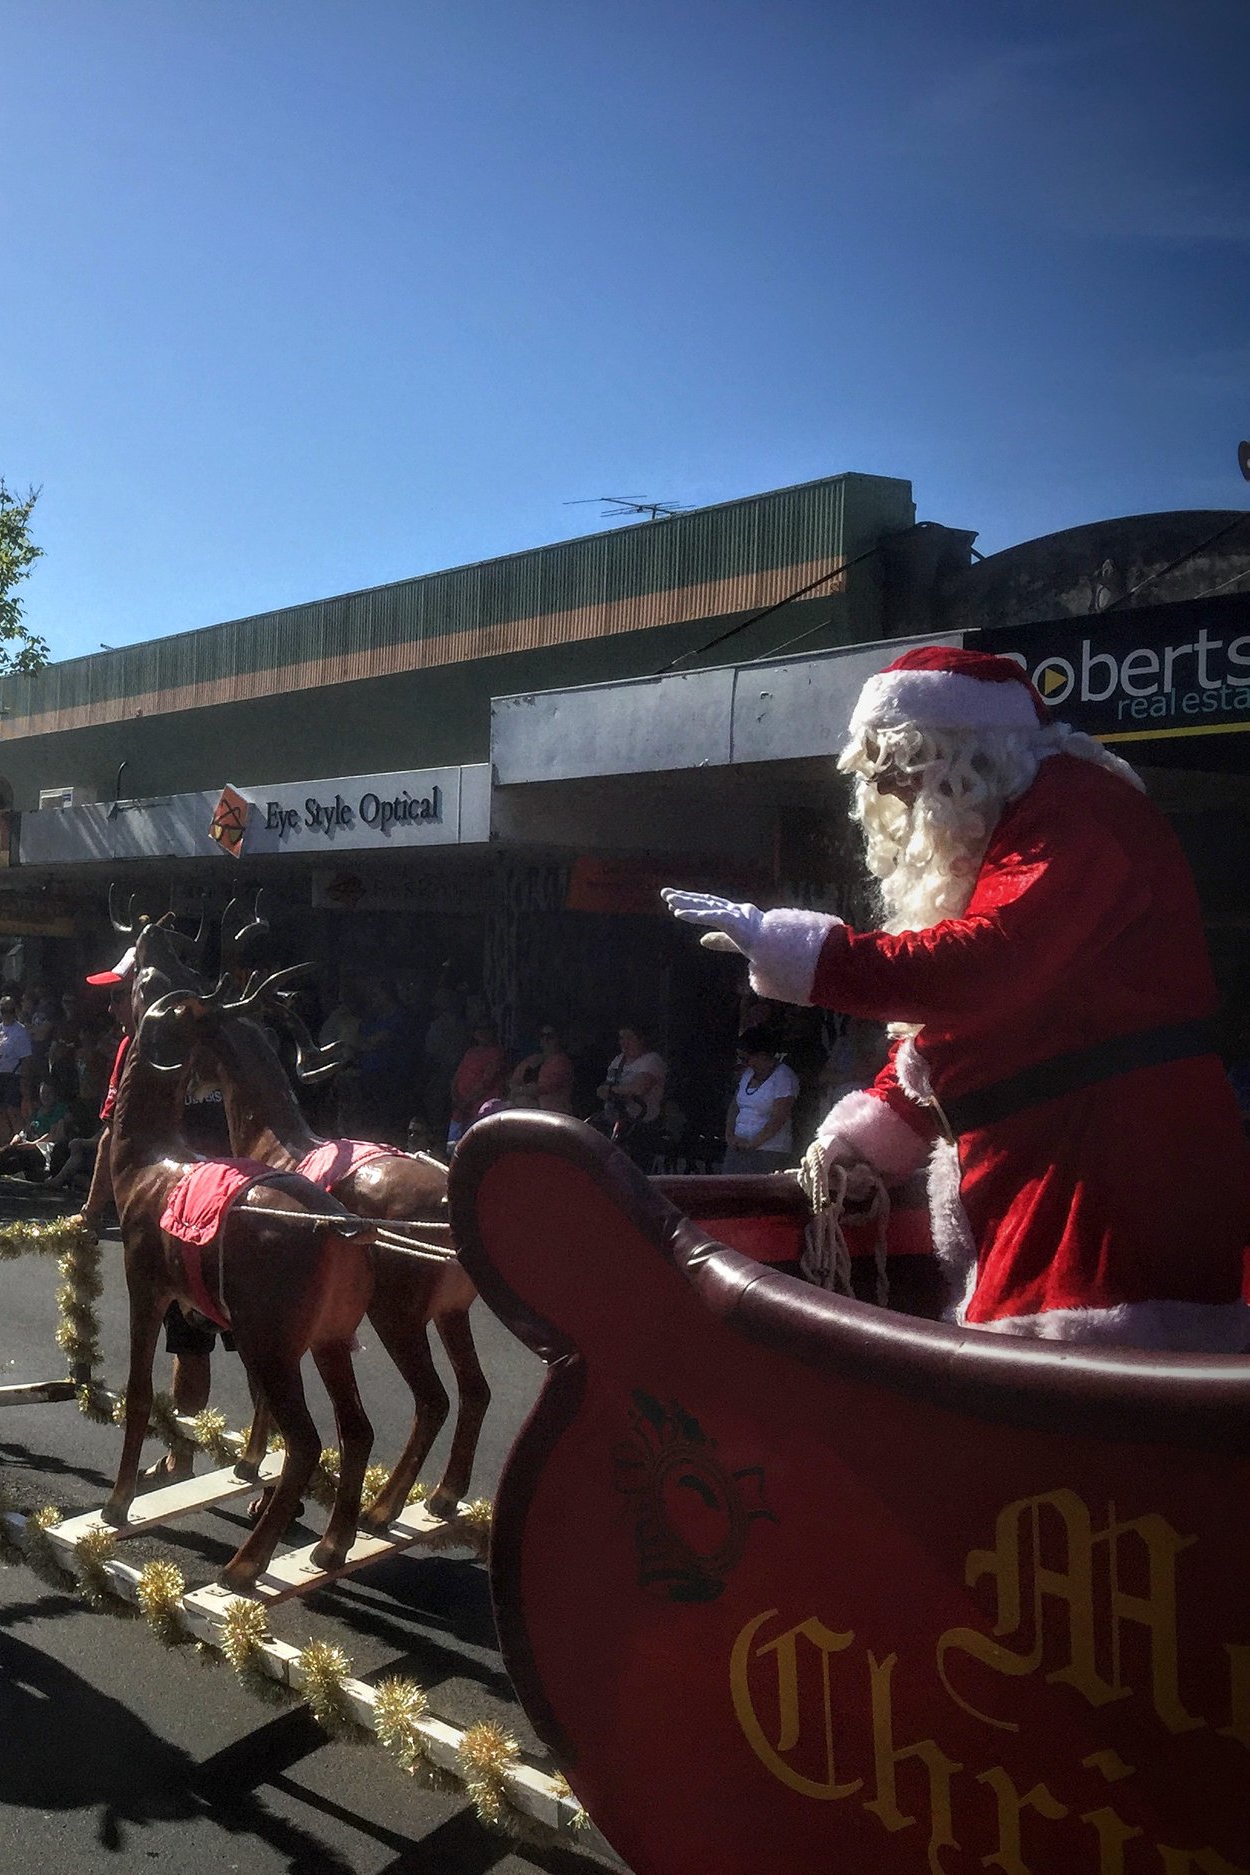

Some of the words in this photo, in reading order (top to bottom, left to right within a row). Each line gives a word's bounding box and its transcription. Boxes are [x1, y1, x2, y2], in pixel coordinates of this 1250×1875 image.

[1118, 687, 1176, 720] real
[1182, 684, 1250, 714] esta
[265, 801, 298, 838] Eye
[304, 794, 352, 835] Style
[359, 785, 439, 832] Optical
